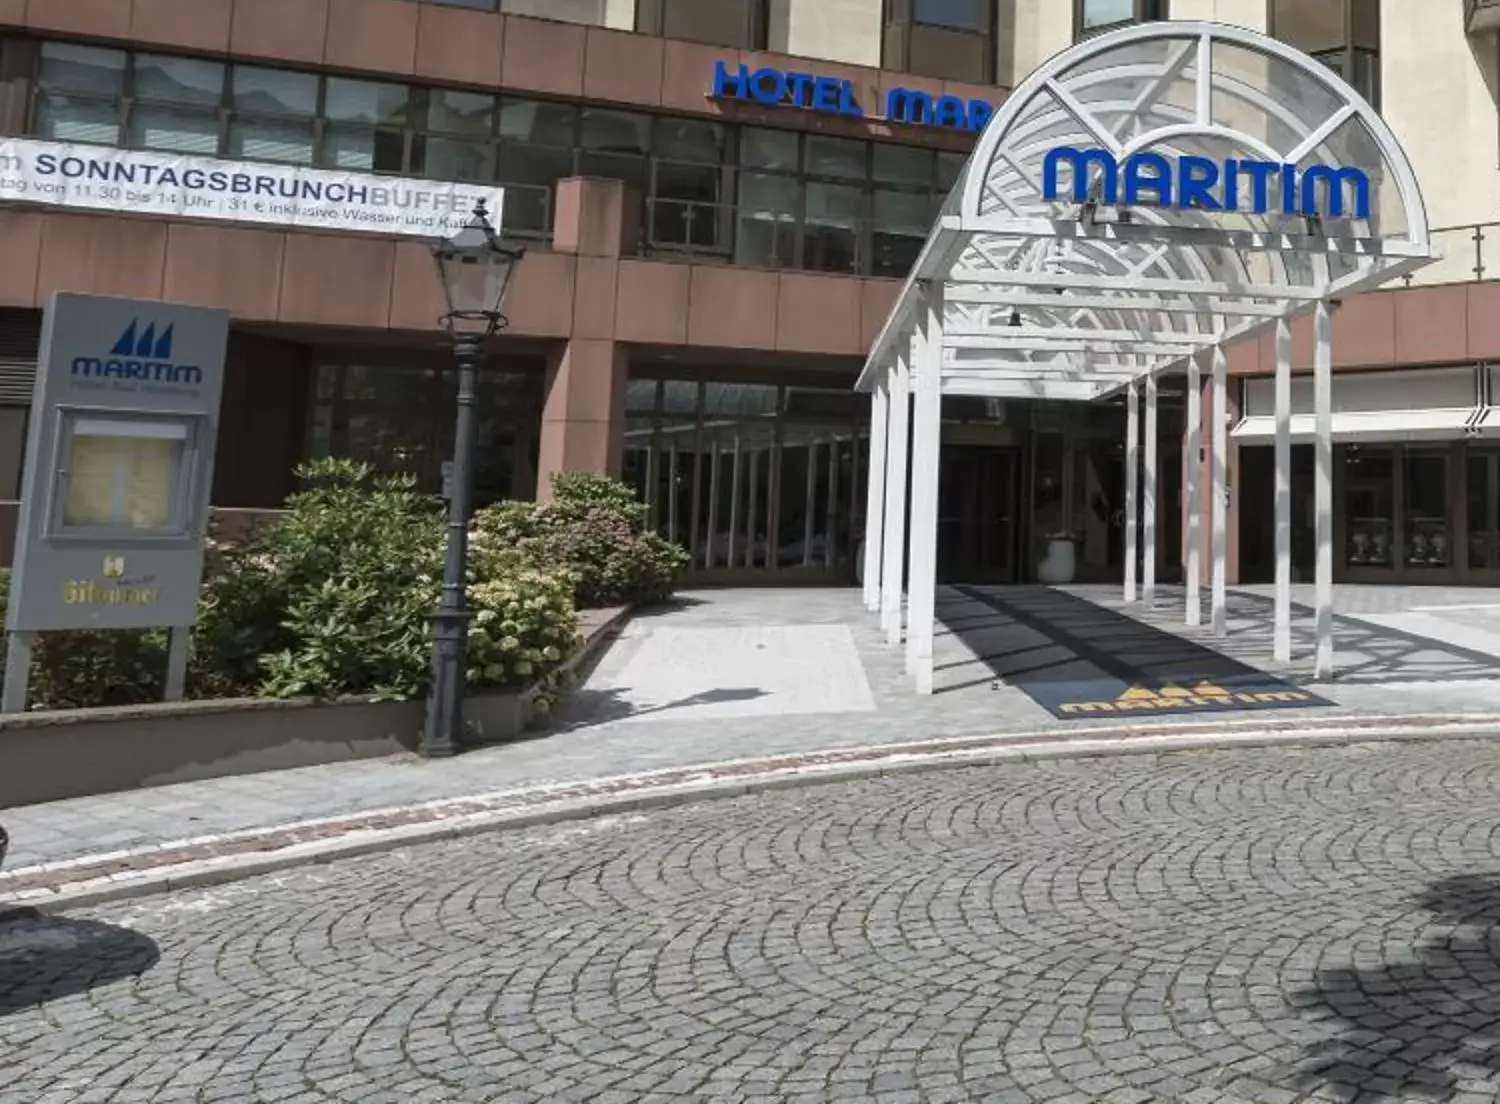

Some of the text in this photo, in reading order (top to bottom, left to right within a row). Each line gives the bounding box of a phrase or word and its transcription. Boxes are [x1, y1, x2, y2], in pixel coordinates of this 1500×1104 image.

[713, 60, 864, 117] HOTEL
[35, 153, 482, 214] SONNTAGSBRUNCHBUFFE
[1043, 146, 1371, 220] MARITIM
[71, 356, 203, 384] MARITIM
